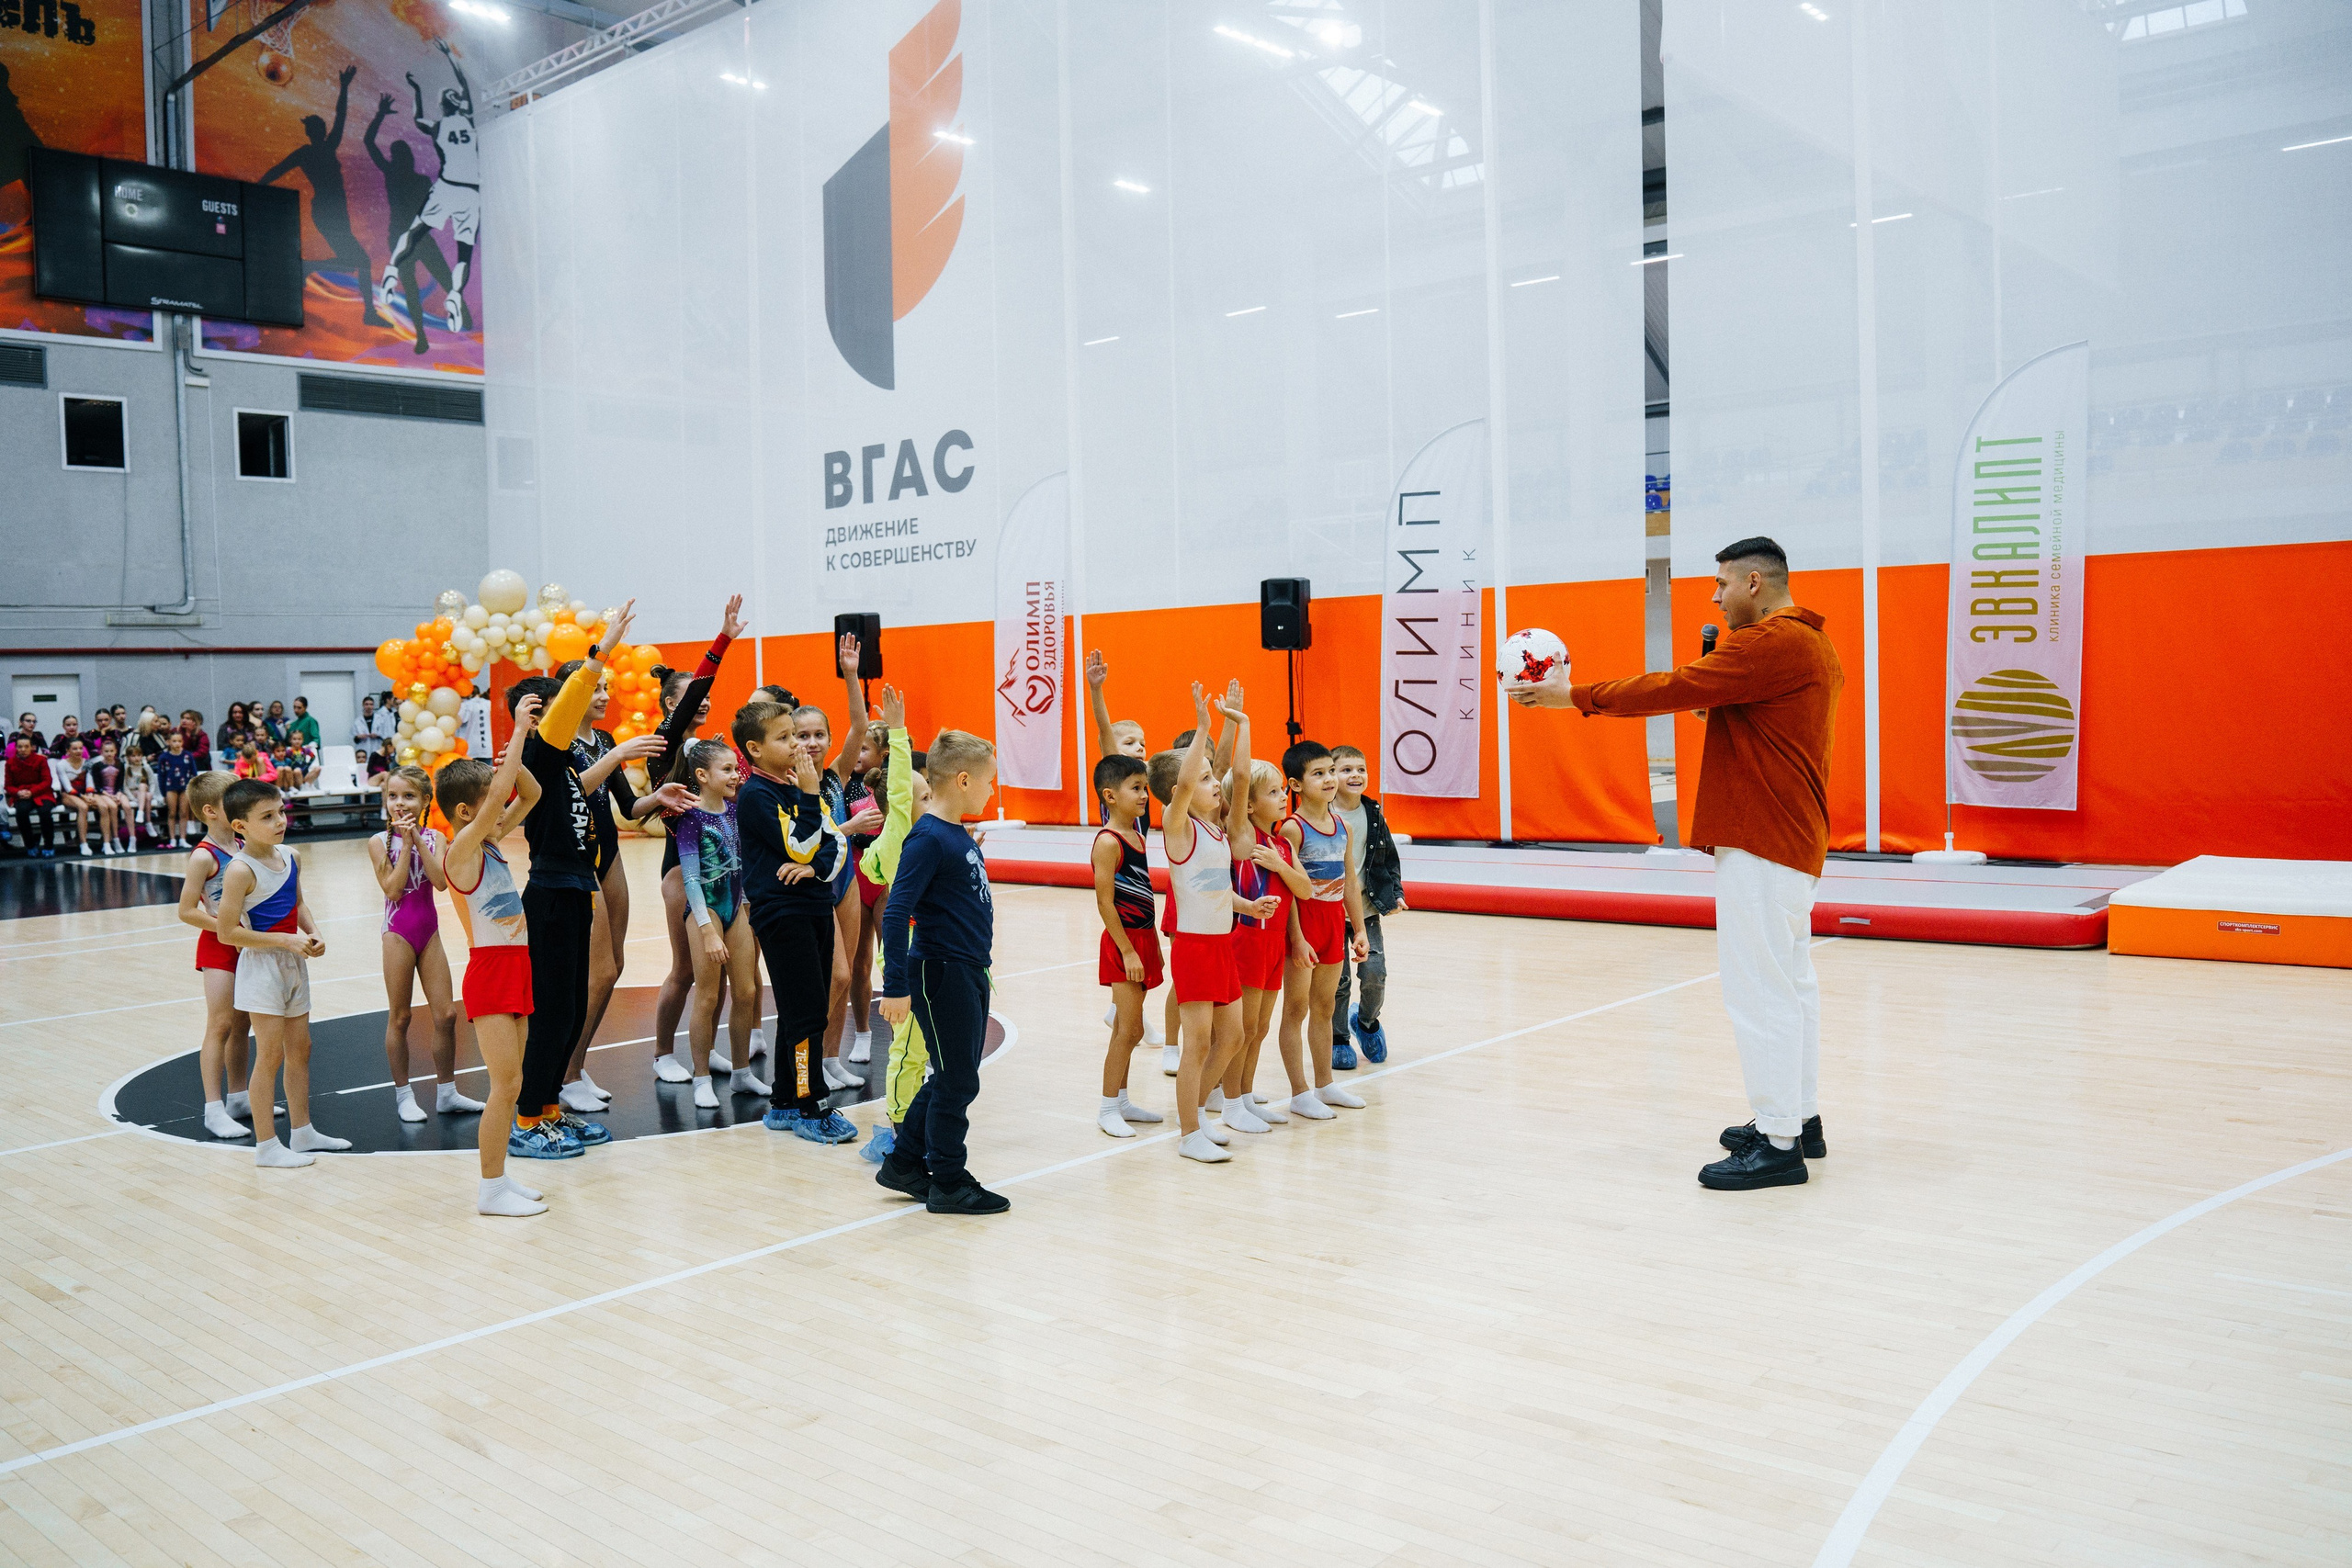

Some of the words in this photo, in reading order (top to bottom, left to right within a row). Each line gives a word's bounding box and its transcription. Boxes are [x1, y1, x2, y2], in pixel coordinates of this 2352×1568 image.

[447, 130, 470, 145] 45
[114, 186, 143, 201] HOME
[201, 199, 238, 216] GUESTS
[824, 429, 975, 510] ВГАС
[2053, 430, 2065, 503] медицины
[825, 517, 919, 547] ДВИЖЕНИЕ
[827, 555, 836, 571] К
[840, 538, 977, 570] СОВЕРШЕНСТВУ
[1970, 435, 2042, 643] ЭВКАЛИПТ
[2050, 509, 2063, 580] семейной
[1026, 581, 1040, 671] ОЛИМП
[1044, 581, 1057, 670] ЗДОРОВЬЯ
[1393, 491, 1441, 775] ОЛИМП
[1459, 548, 1476, 720] КЛИНИК
[2050, 585, 2061, 642] клиника
